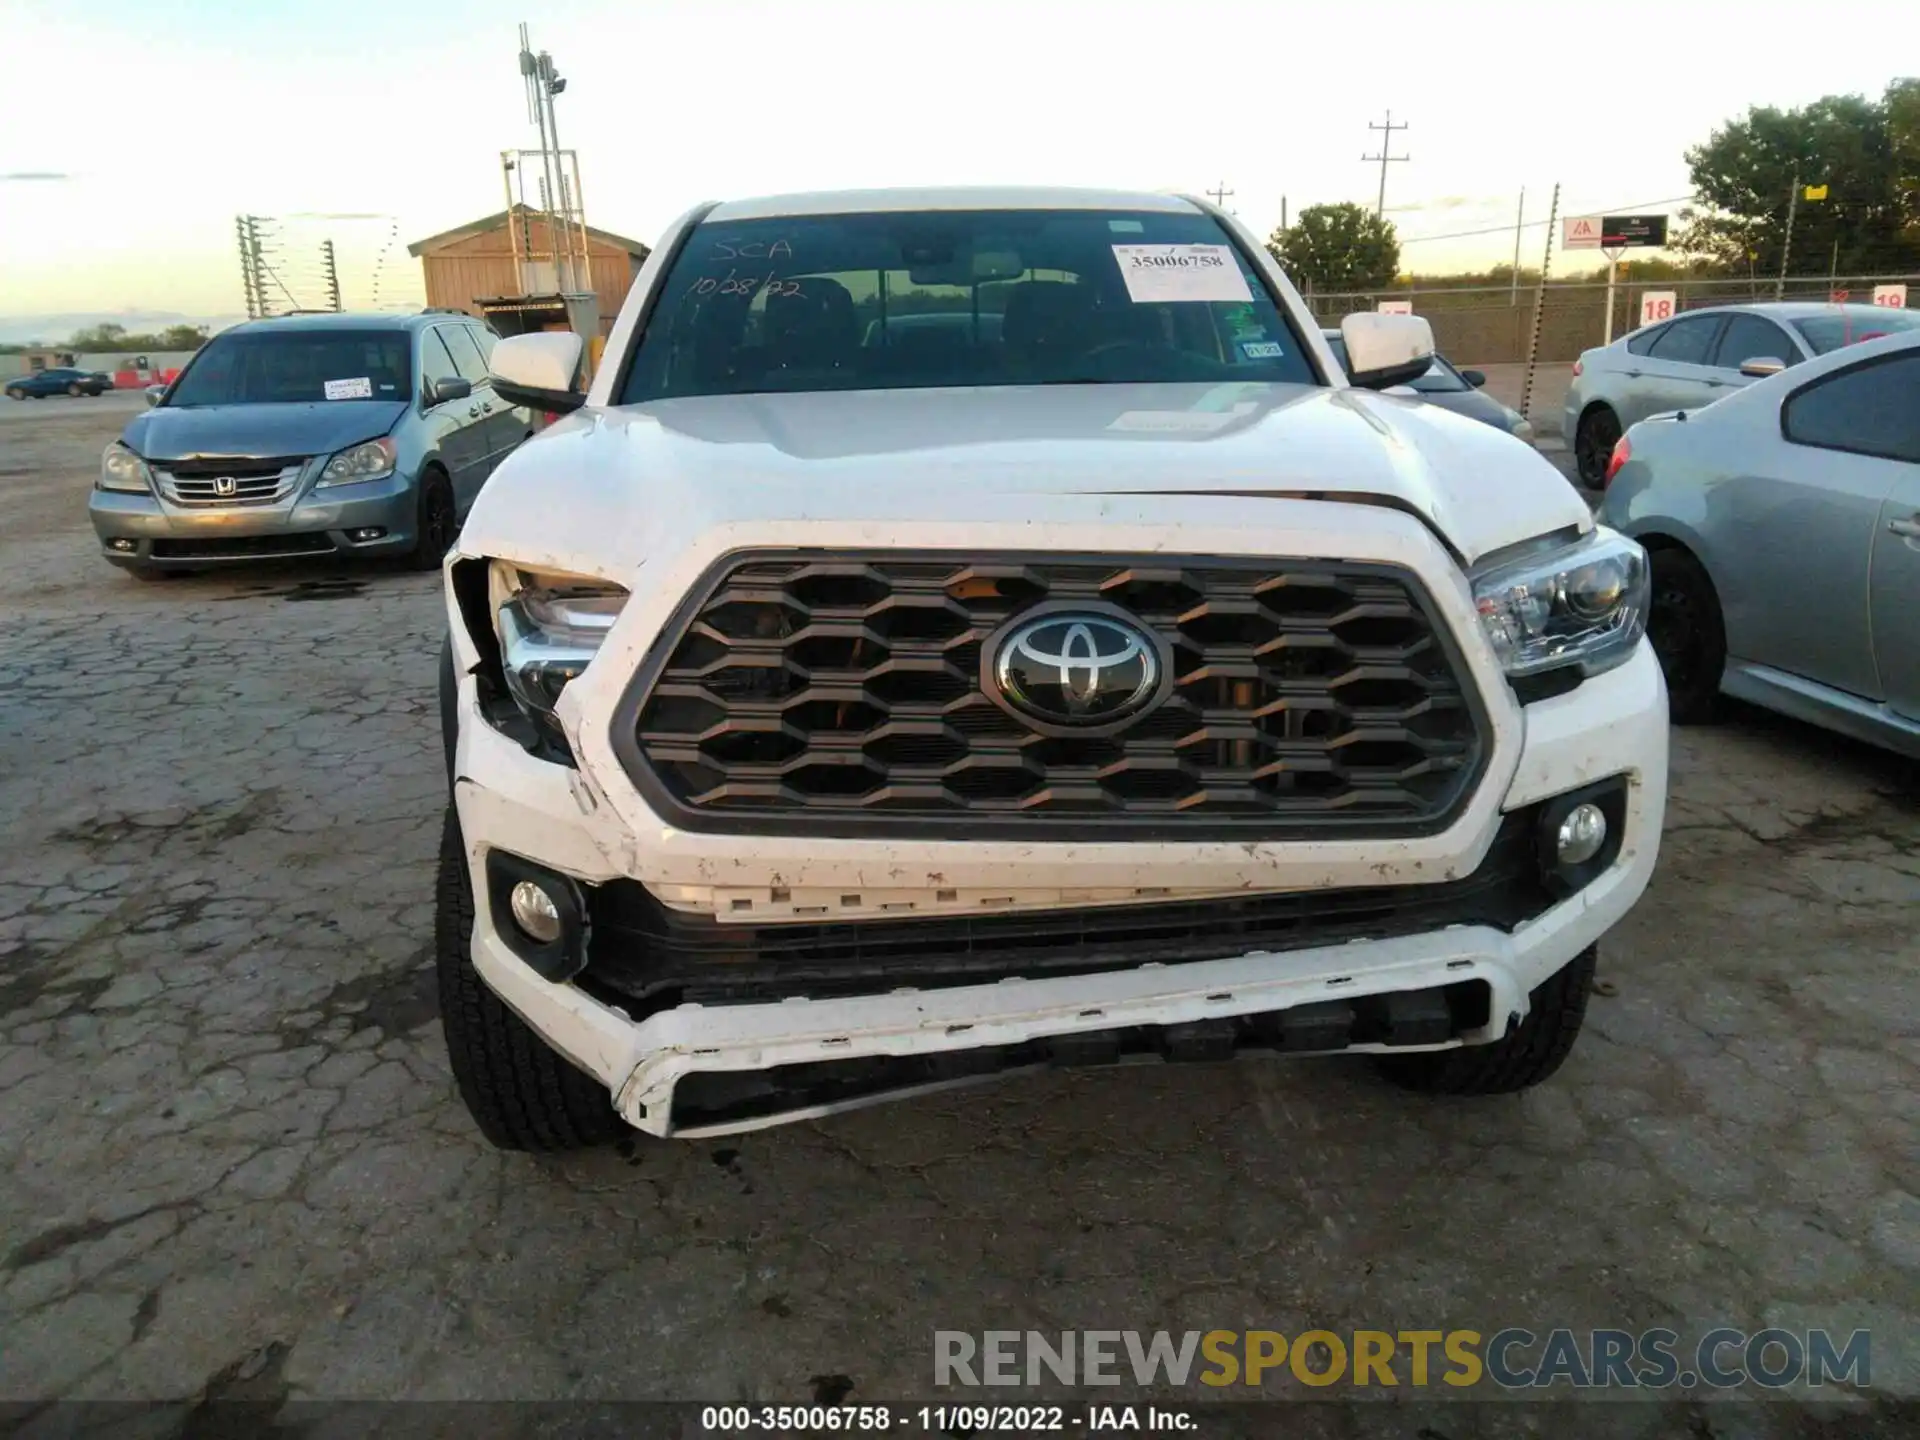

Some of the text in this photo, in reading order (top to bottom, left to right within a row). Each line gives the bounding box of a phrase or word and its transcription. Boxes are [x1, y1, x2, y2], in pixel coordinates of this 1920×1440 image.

[709, 238, 792, 261] SCA
[1131, 256, 1224, 268] 35006758
[686, 268, 808, 299] 10/28/22
[1645, 300, 1670, 320] 18
